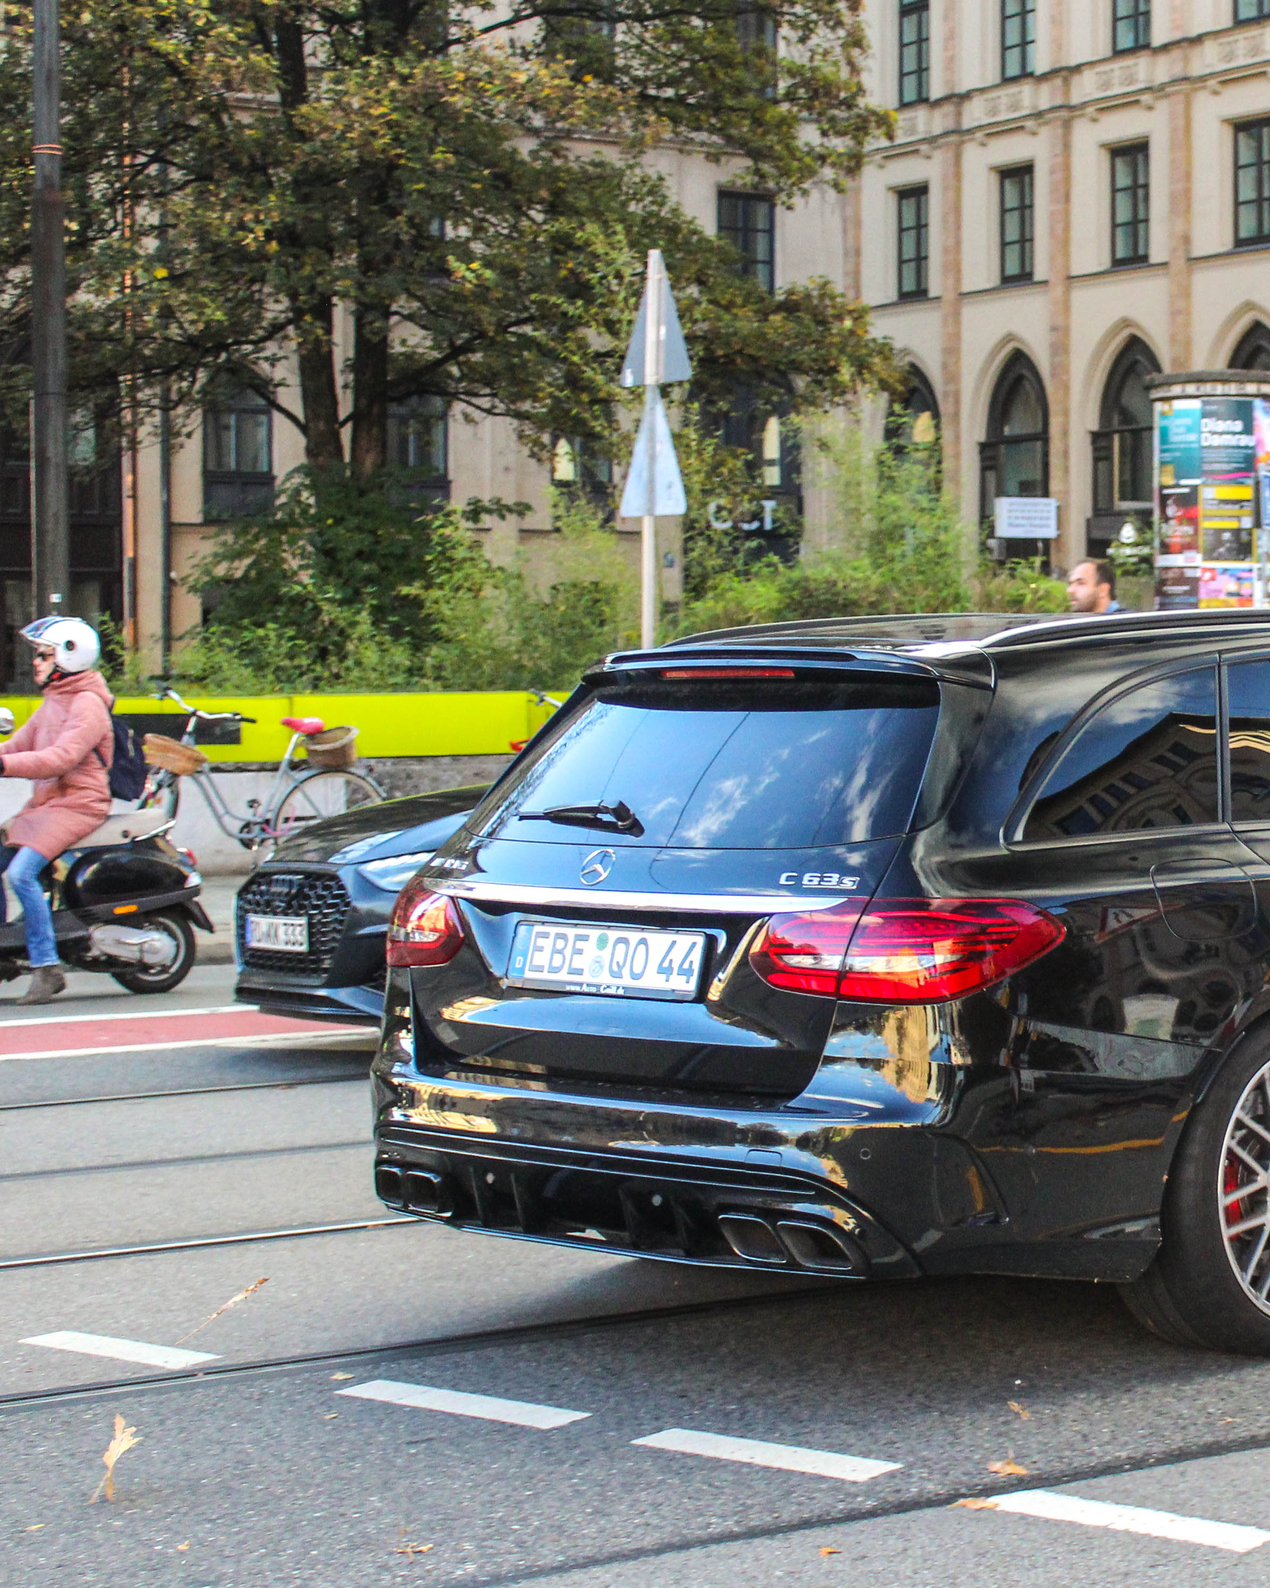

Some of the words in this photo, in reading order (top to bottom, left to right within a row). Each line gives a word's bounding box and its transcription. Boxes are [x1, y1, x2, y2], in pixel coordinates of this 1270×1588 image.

[1200, 418, 1244, 432] Diana
[1200, 433, 1256, 447] Damrau
[778, 872, 798, 885] C
[514, 956, 524, 968] D
[527, 931, 591, 976] EBE
[608, 936, 650, 981] QO
[656, 940, 698, 984] 44
